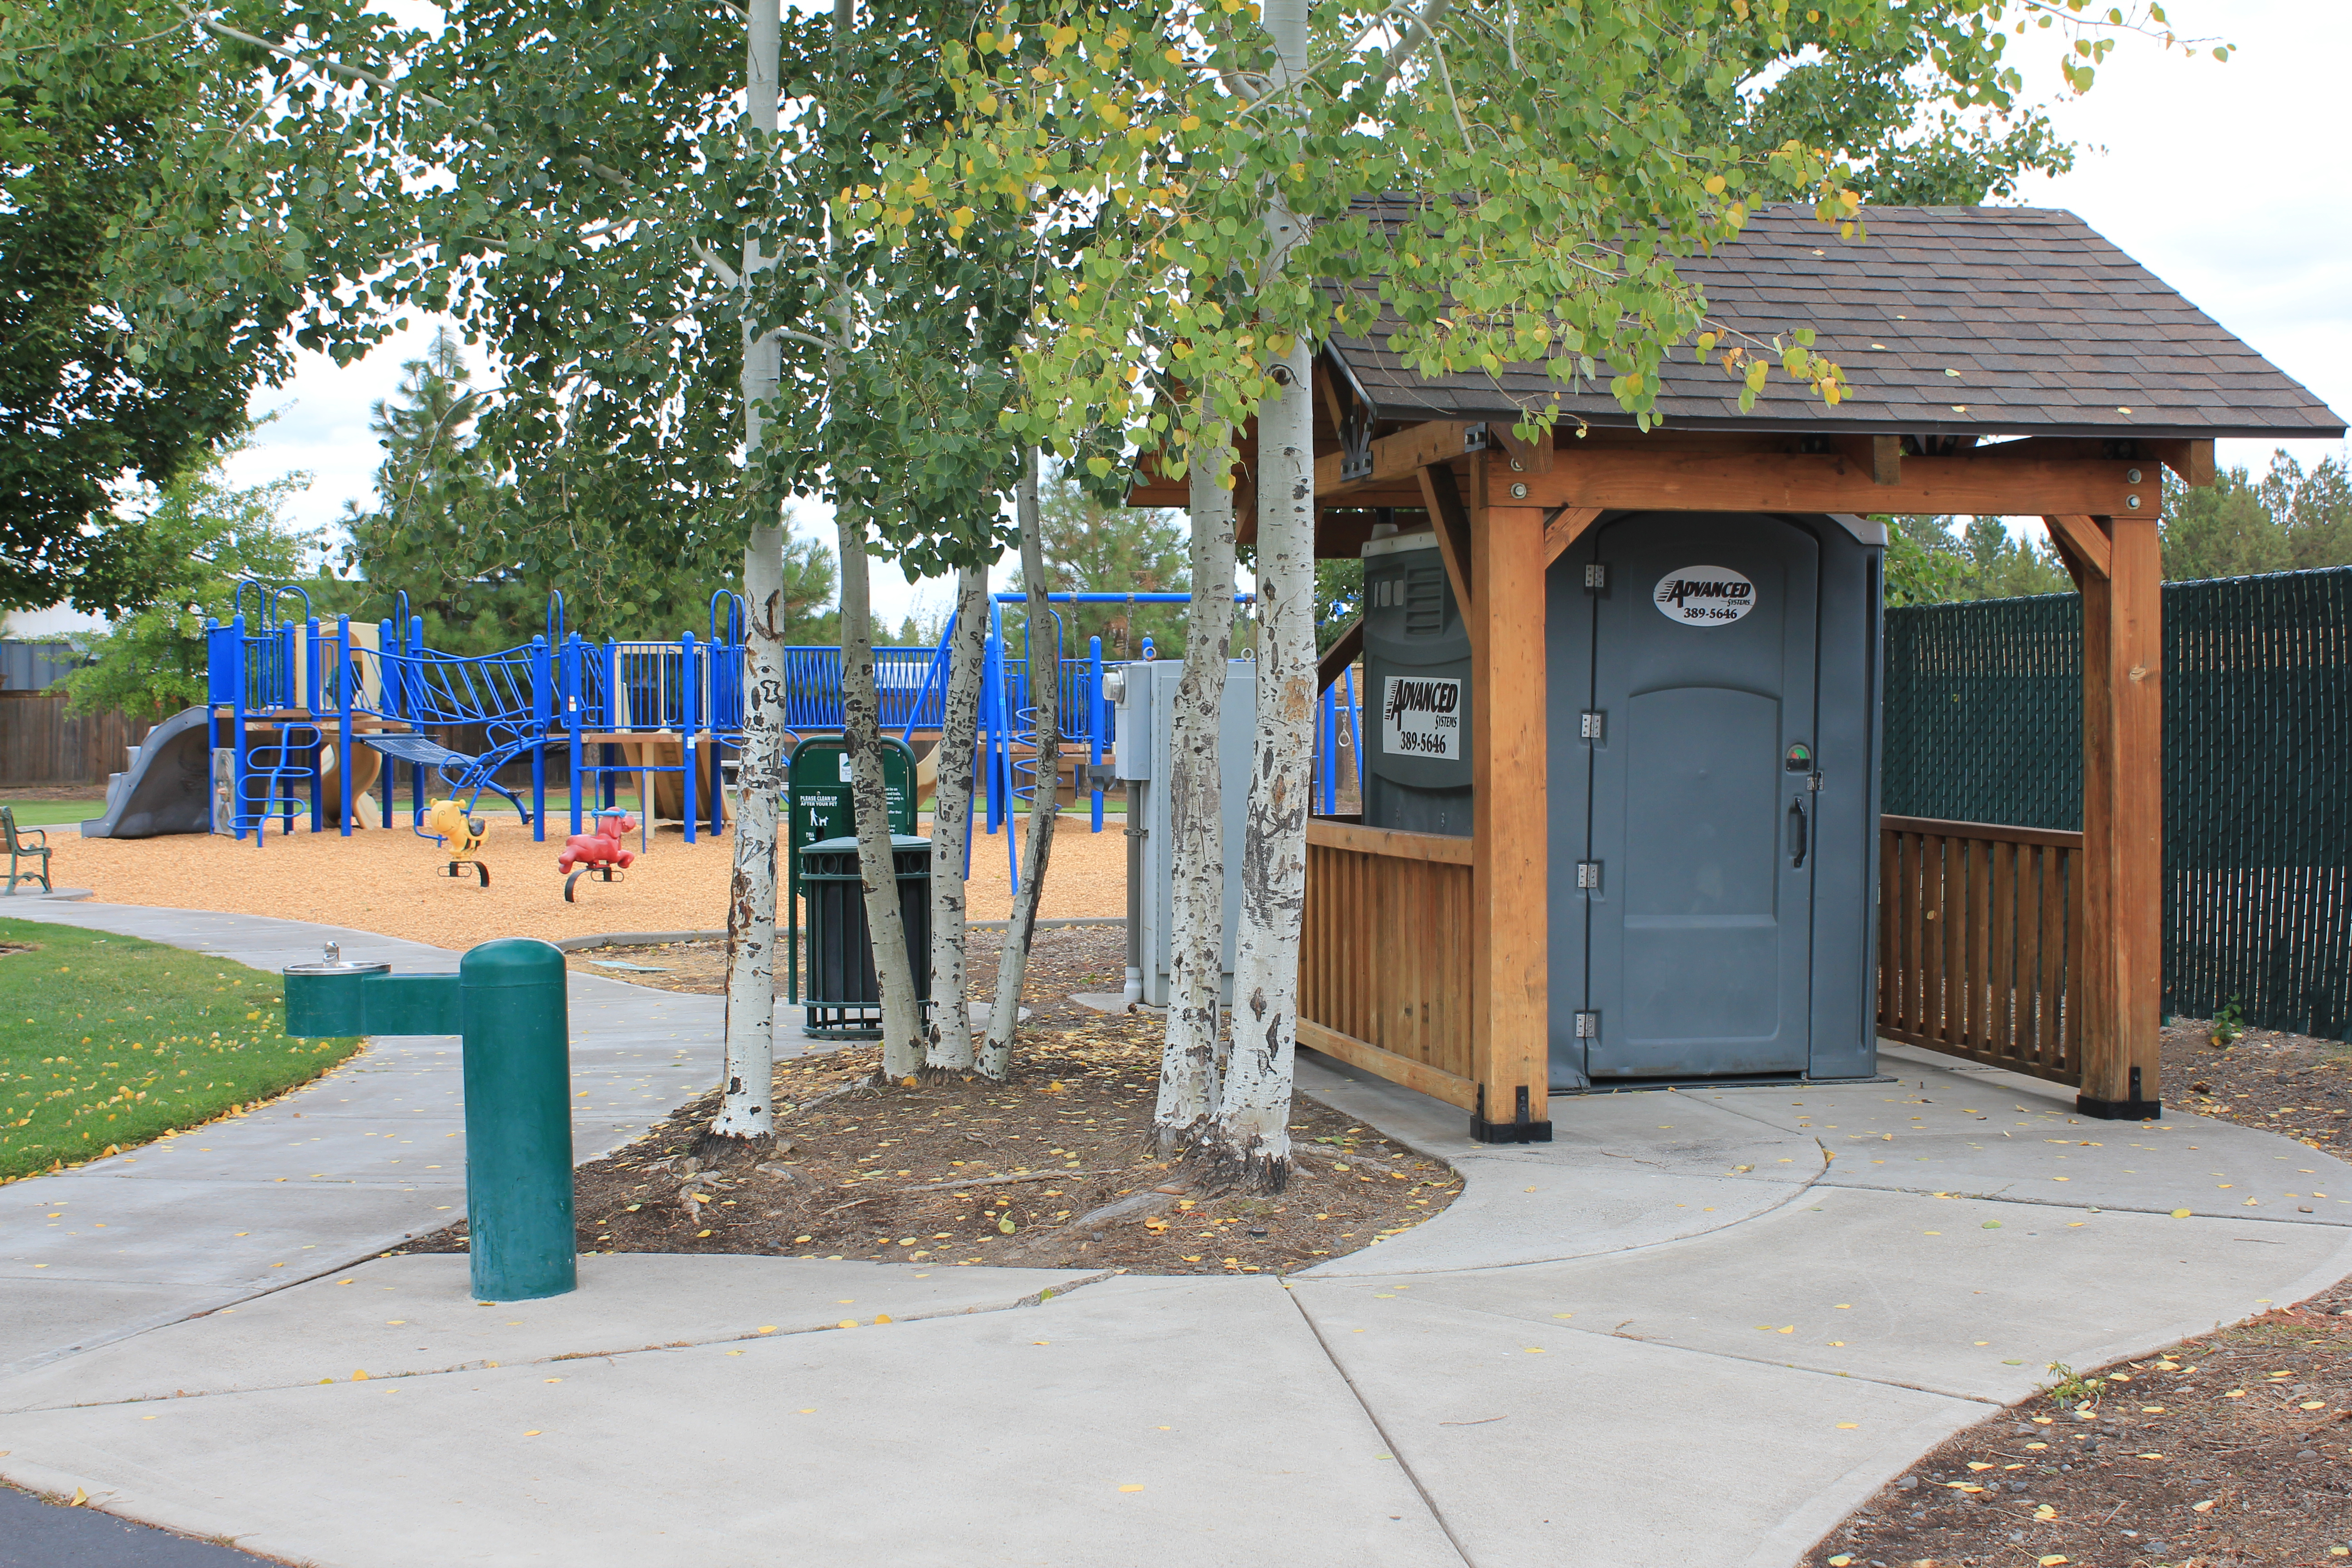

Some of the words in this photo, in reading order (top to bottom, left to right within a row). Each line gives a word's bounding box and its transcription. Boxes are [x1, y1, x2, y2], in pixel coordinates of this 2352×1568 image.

[1664, 579, 1751, 608] ADVANCED
[1684, 608, 1737, 618] 389-5646
[1389, 679, 1458, 731] ADVANCED
[1435, 715, 1457, 730] SYSTEMS
[1401, 731, 1446, 754] 389-5646
